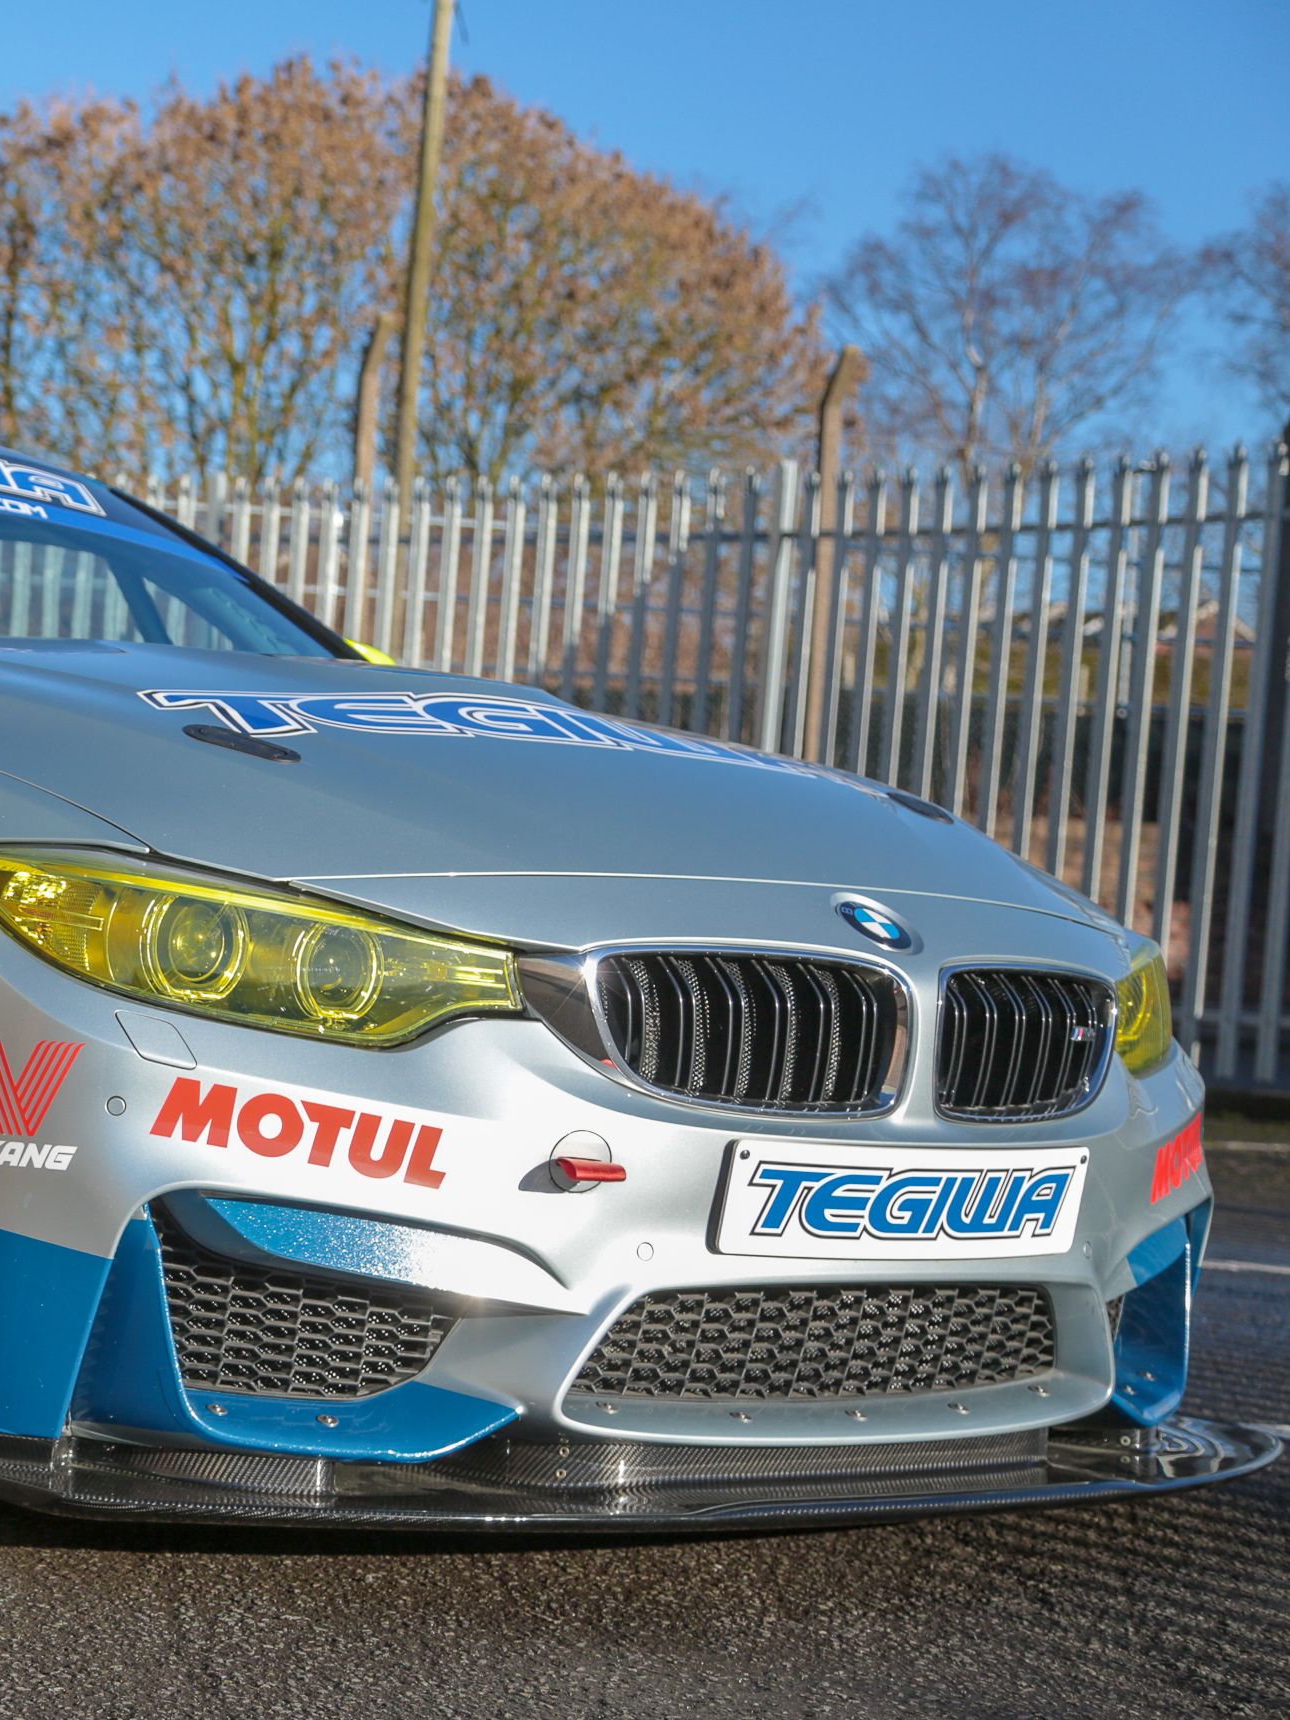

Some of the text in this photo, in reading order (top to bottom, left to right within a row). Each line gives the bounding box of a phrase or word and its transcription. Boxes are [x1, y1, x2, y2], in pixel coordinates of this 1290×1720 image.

[136, 690, 890, 798] TEGIW
[149, 1076, 447, 1190] MOTUL
[747, 1160, 1077, 1241] TEGIWA
